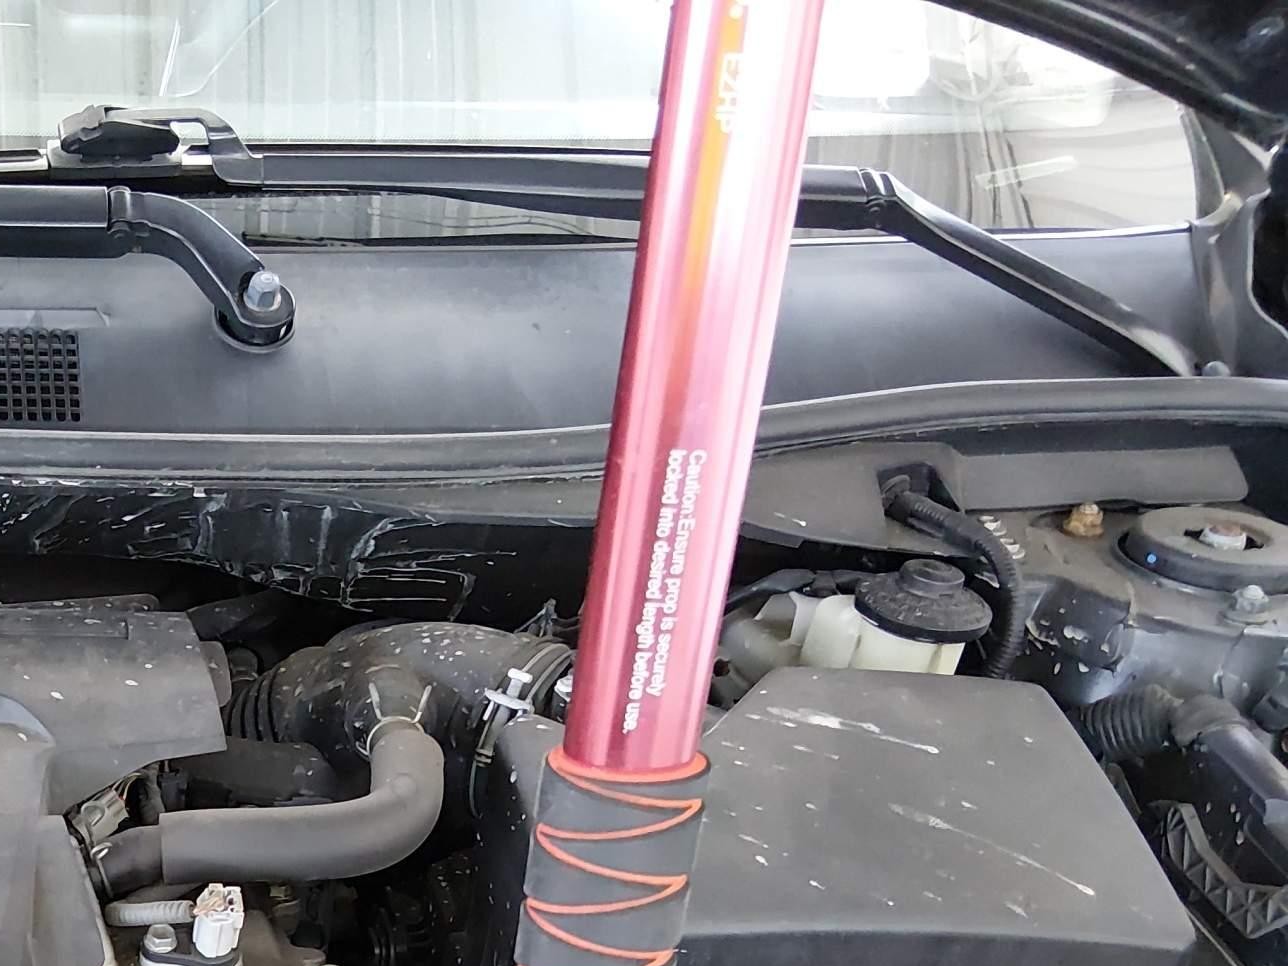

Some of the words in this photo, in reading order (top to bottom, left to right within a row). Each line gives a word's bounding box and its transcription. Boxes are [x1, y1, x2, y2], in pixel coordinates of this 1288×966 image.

[661, 449, 686, 504] locked
[655, 508, 675, 538] into
[646, 541, 670, 600] desired
[658, 578, 681, 613] prop
[636, 602, 663, 649] length
[660, 616, 676, 630] is
[629, 651, 652, 700] before
[647, 633, 672, 697] securely
[622, 702, 641, 735] use.
